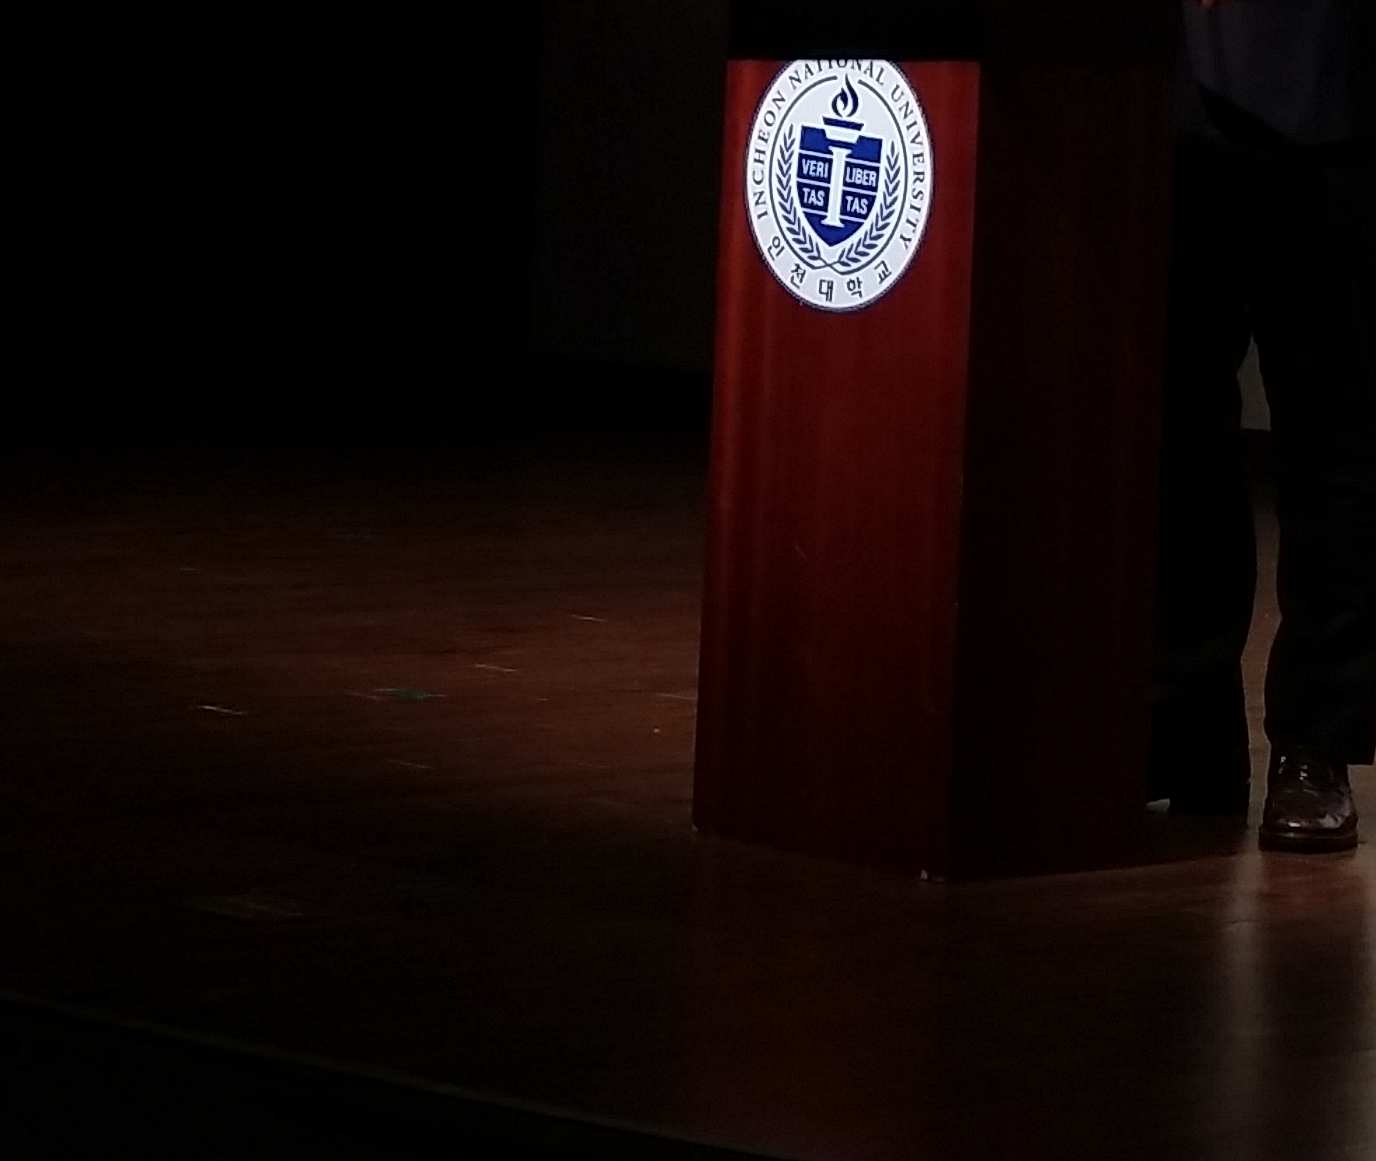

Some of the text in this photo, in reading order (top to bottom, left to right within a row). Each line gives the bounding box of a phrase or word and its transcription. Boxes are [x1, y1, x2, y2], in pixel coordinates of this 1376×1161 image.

[751, 59, 925, 251] INCHEON NATIONAL UNIVERSITY
[801, 157, 878, 188] VERI LIBER
[801, 187, 869, 215] TAS TAS
[767, 235, 893, 302] 인천대학교
